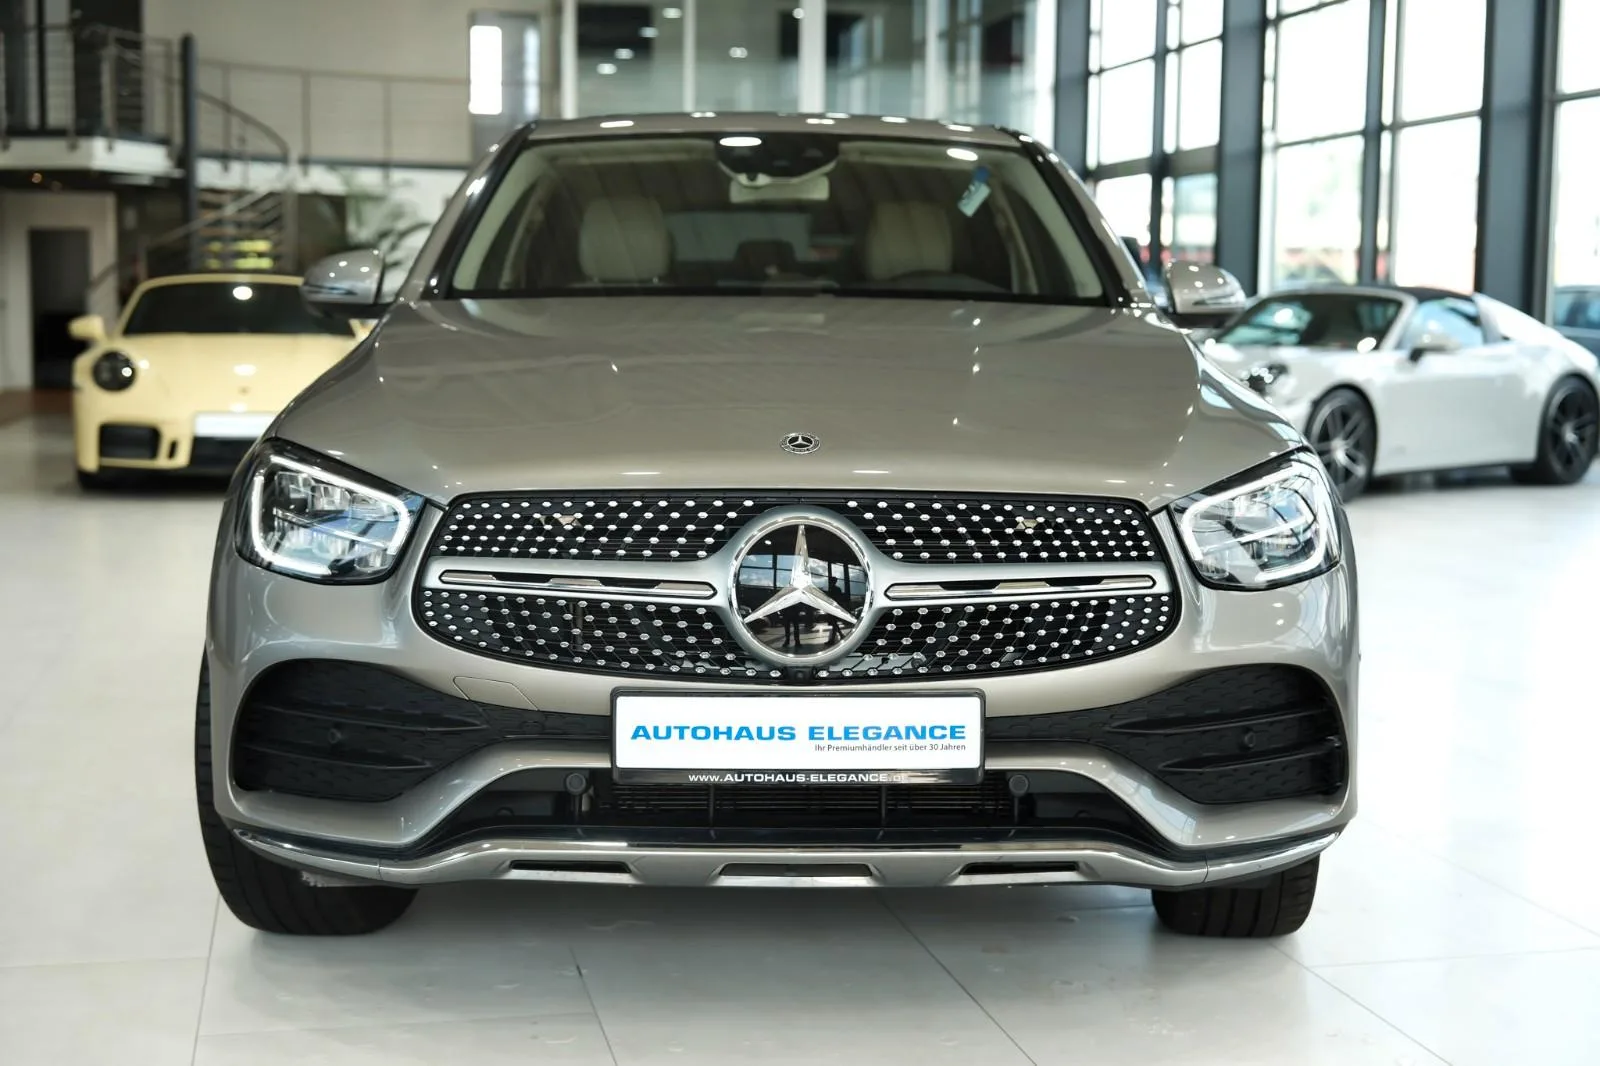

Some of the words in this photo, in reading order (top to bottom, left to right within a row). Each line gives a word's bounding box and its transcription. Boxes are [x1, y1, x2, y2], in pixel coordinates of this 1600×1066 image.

[631, 725, 796, 741] AUTOHAUS
[808, 725, 966, 741] ELEGANCE
[815, 744, 826, 752] Ihr
[827, 744, 893, 752] Premiumhändler
[894, 744, 908, 752] seit
[909, 743, 927, 752] über
[929, 743, 939, 751] 30
[940, 743, 966, 751] Jahren
[688, 773, 910, 783] www.AUTOHAUS-ELEGANCE.d
